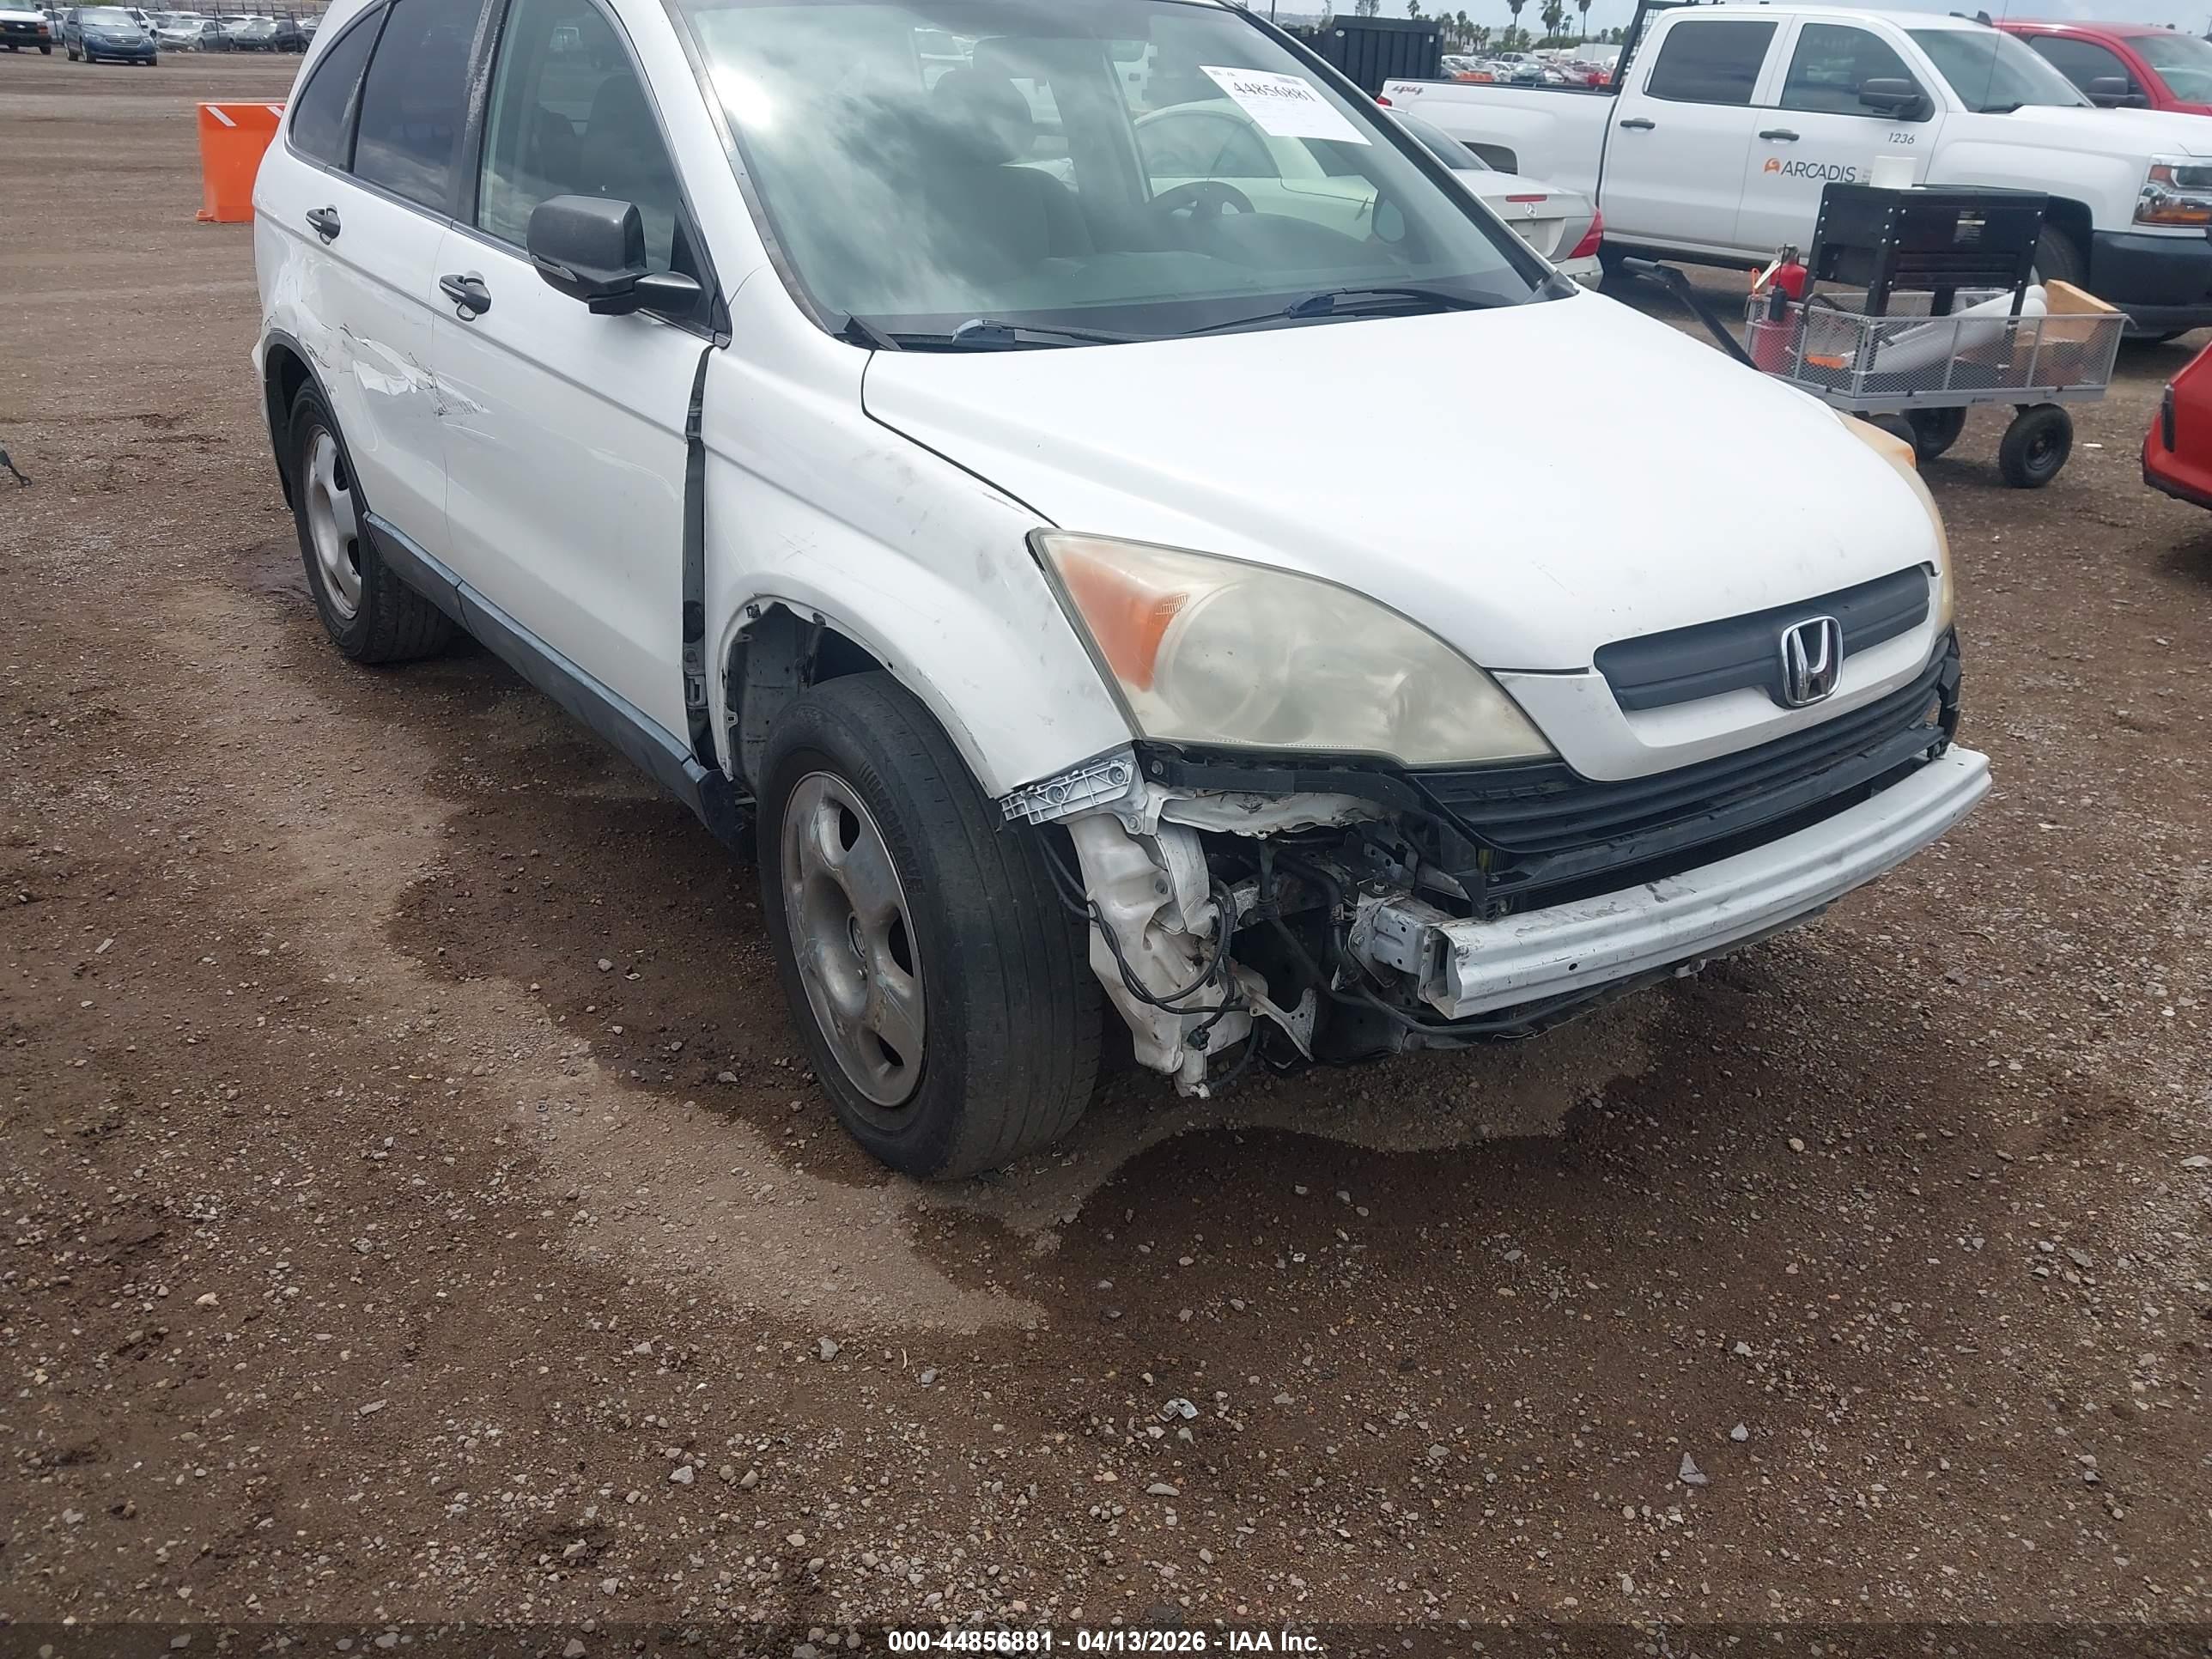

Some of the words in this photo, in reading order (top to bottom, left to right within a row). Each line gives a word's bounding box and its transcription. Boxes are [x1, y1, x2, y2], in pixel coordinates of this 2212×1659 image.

[1233, 82, 1316, 102] 44856881
[1888, 132, 1915, 145] 1236
[1780, 160, 1856, 183] ARCADIS
